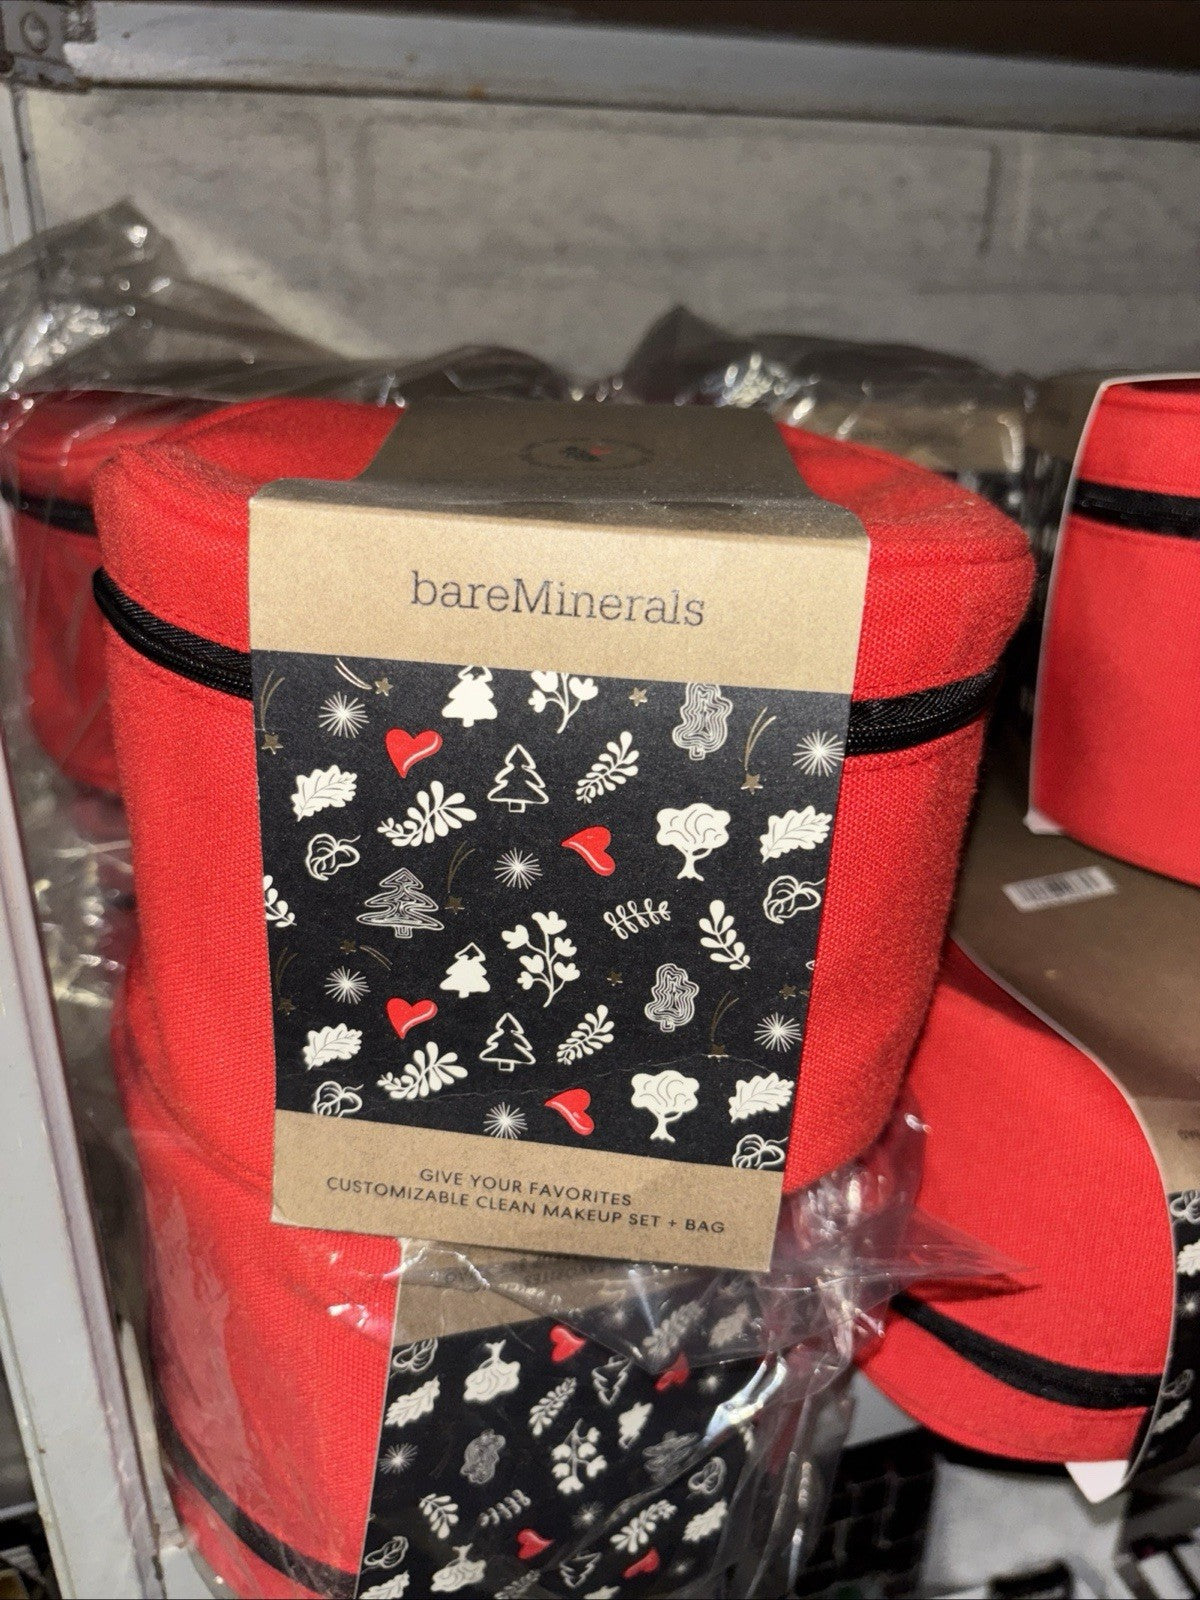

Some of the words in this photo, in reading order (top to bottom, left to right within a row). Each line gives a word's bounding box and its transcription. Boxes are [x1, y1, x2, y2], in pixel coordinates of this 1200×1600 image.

[410, 569, 705, 627] bareMinerals
[326, 1176, 470, 1207] CUSTOMIZABLE
[475, 1195, 537, 1215] CLEAN
[542, 1204, 623, 1223] MAKEUP
[628, 1212, 662, 1228] SET
[667, 1219, 677, 1228] +
[684, 1218, 726, 1234] BAG
[419, 1167, 464, 1186] GIVE
[470, 1173, 523, 1194] YOUR
[529, 1181, 633, 1207] FAVORITES
